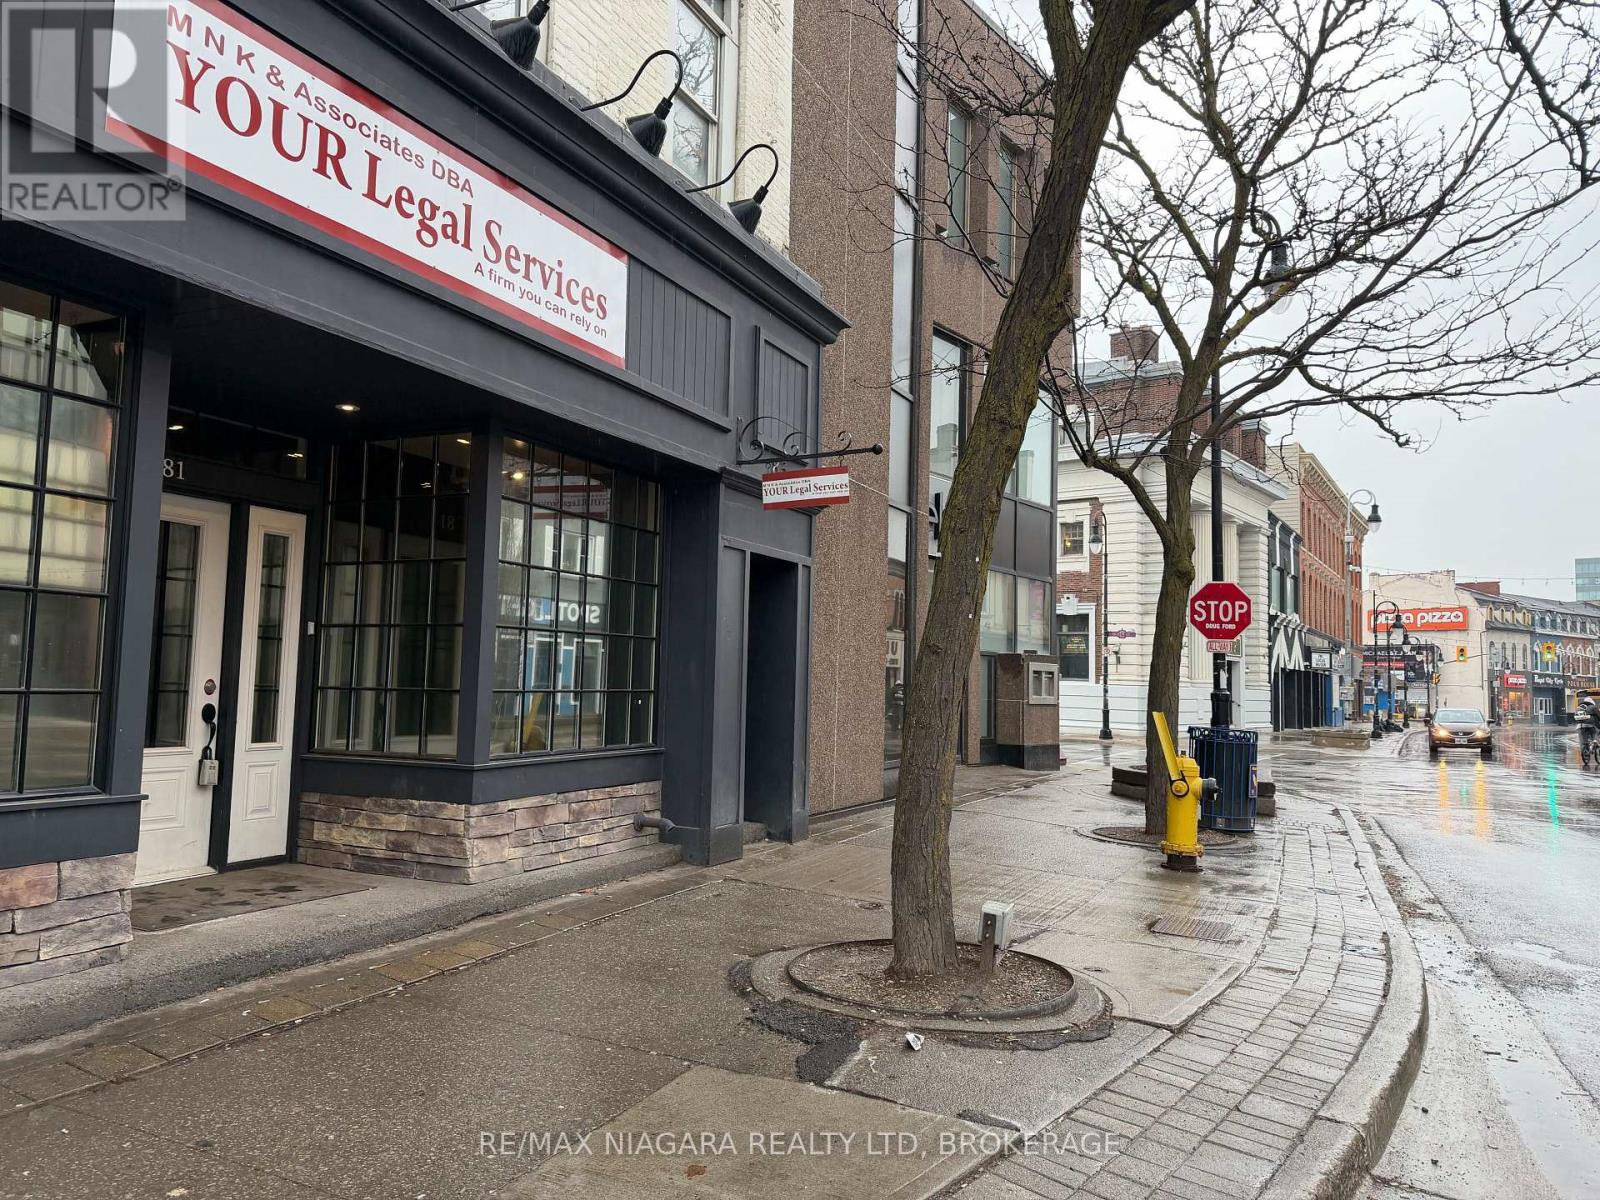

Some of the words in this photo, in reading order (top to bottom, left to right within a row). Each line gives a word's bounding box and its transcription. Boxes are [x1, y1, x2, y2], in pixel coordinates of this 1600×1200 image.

[267, 65, 285, 90] &
[294, 82, 424, 169] Associates
[432, 159, 474, 198] DBA
[166, 40, 352, 190] YOUR
[362, 150, 473, 252] Legal
[482, 219, 608, 320] Services
[474, 262, 484, 277] A
[488, 269, 515, 292] firm
[519, 285, 541, 305] you
[545, 298, 567, 318] can
[570, 312, 591, 331] rely
[594, 324, 607, 338] on
[163, 459, 184, 480] 81
[763, 486, 788, 497] YOUR
[790, 484, 812, 495] Legal
[813, 482, 848, 491] Services
[1194, 601, 1248, 621] STOP
[1417, 611, 1464, 627] pizza
